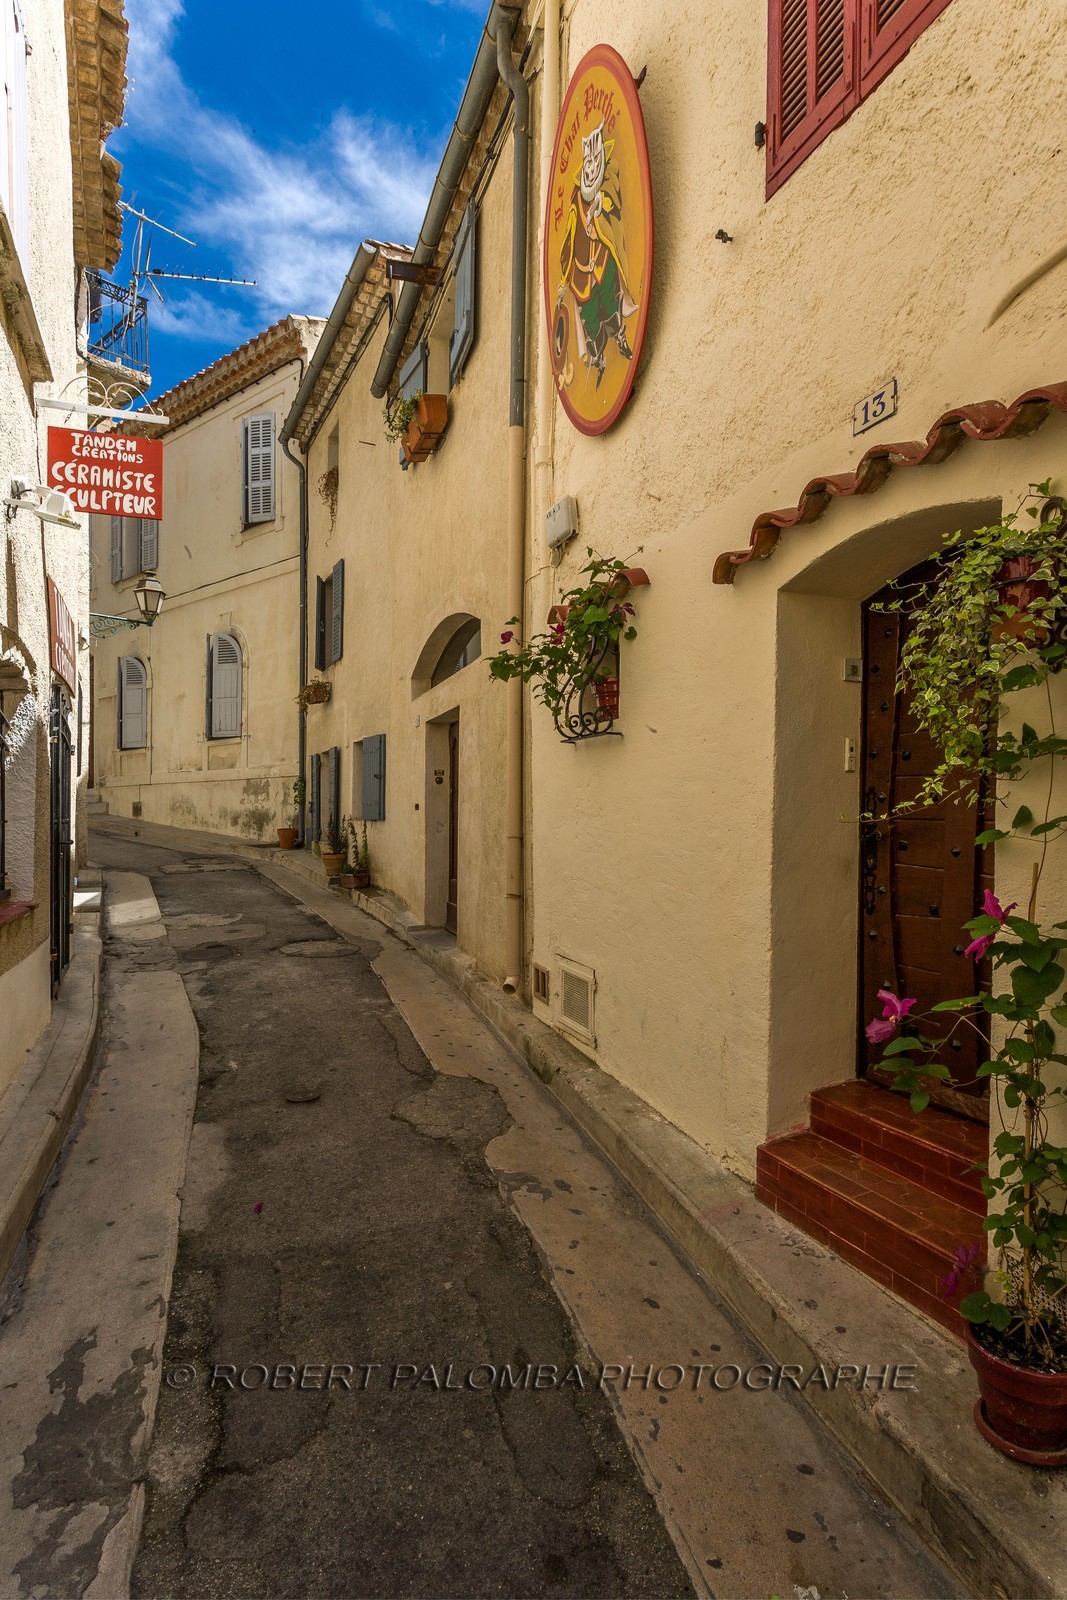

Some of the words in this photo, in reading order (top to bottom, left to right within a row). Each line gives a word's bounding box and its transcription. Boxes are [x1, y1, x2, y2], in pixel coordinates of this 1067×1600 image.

[559, 111, 580, 174] Chat
[583, 82, 621, 134] Perché
[861, 391, 886, 426] 13
[71, 432, 137, 452] TANDEM
[51, 458, 155, 493] CÉRAMISTE
